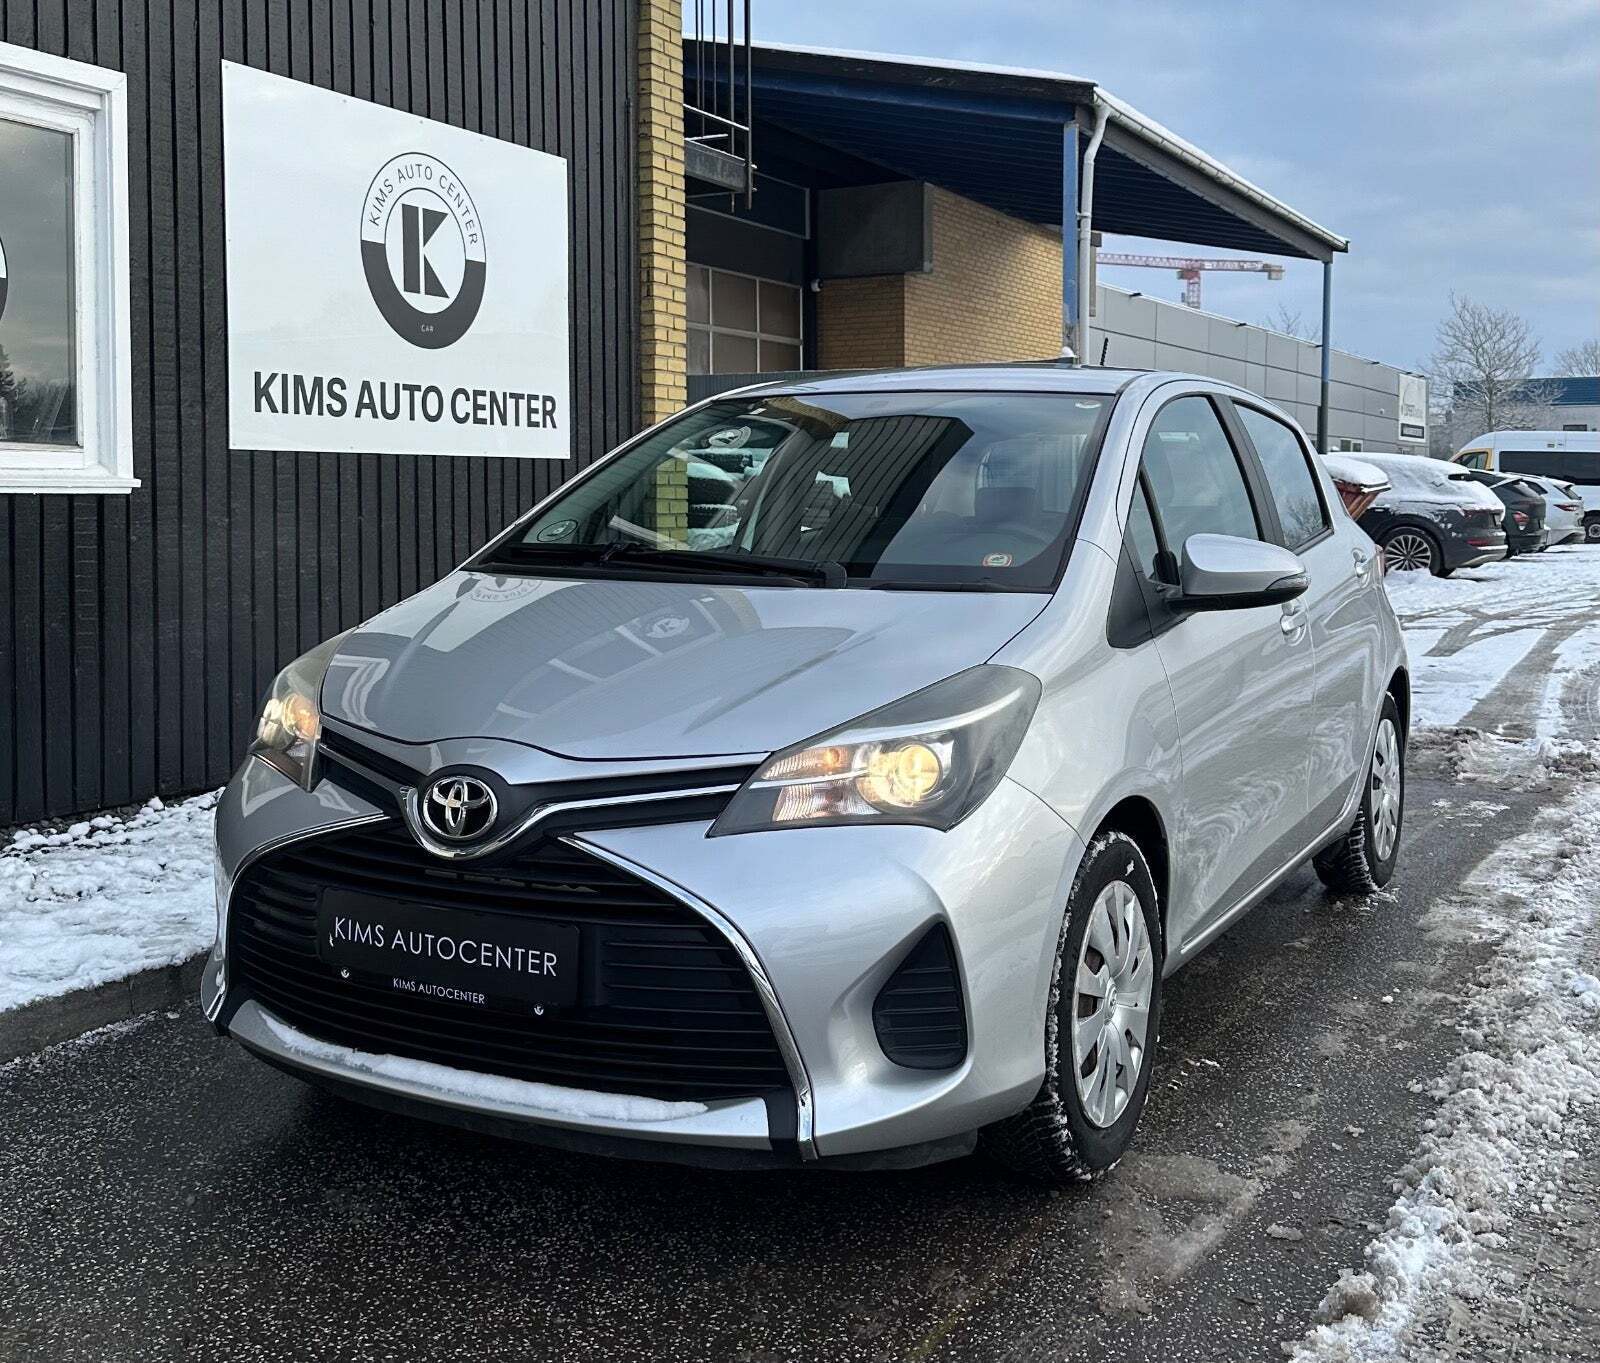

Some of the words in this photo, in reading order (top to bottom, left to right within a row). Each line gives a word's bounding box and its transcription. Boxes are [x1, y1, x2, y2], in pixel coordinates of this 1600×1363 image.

[369, 178, 394, 227] KIMS
[398, 163, 433, 184] AUTO
[439, 175, 478, 245] CENTER
[401, 203, 450, 299] K
[254, 371, 348, 418] KIMS
[354, 380, 444, 423] AUTO
[450, 387, 558, 429] CENTER
[334, 916, 385, 948] KIMS
[391, 929, 557, 977] AUTOCENTER
[393, 978, 416, 992] KIMS
[418, 983, 485, 1004] AUTOCENTER
